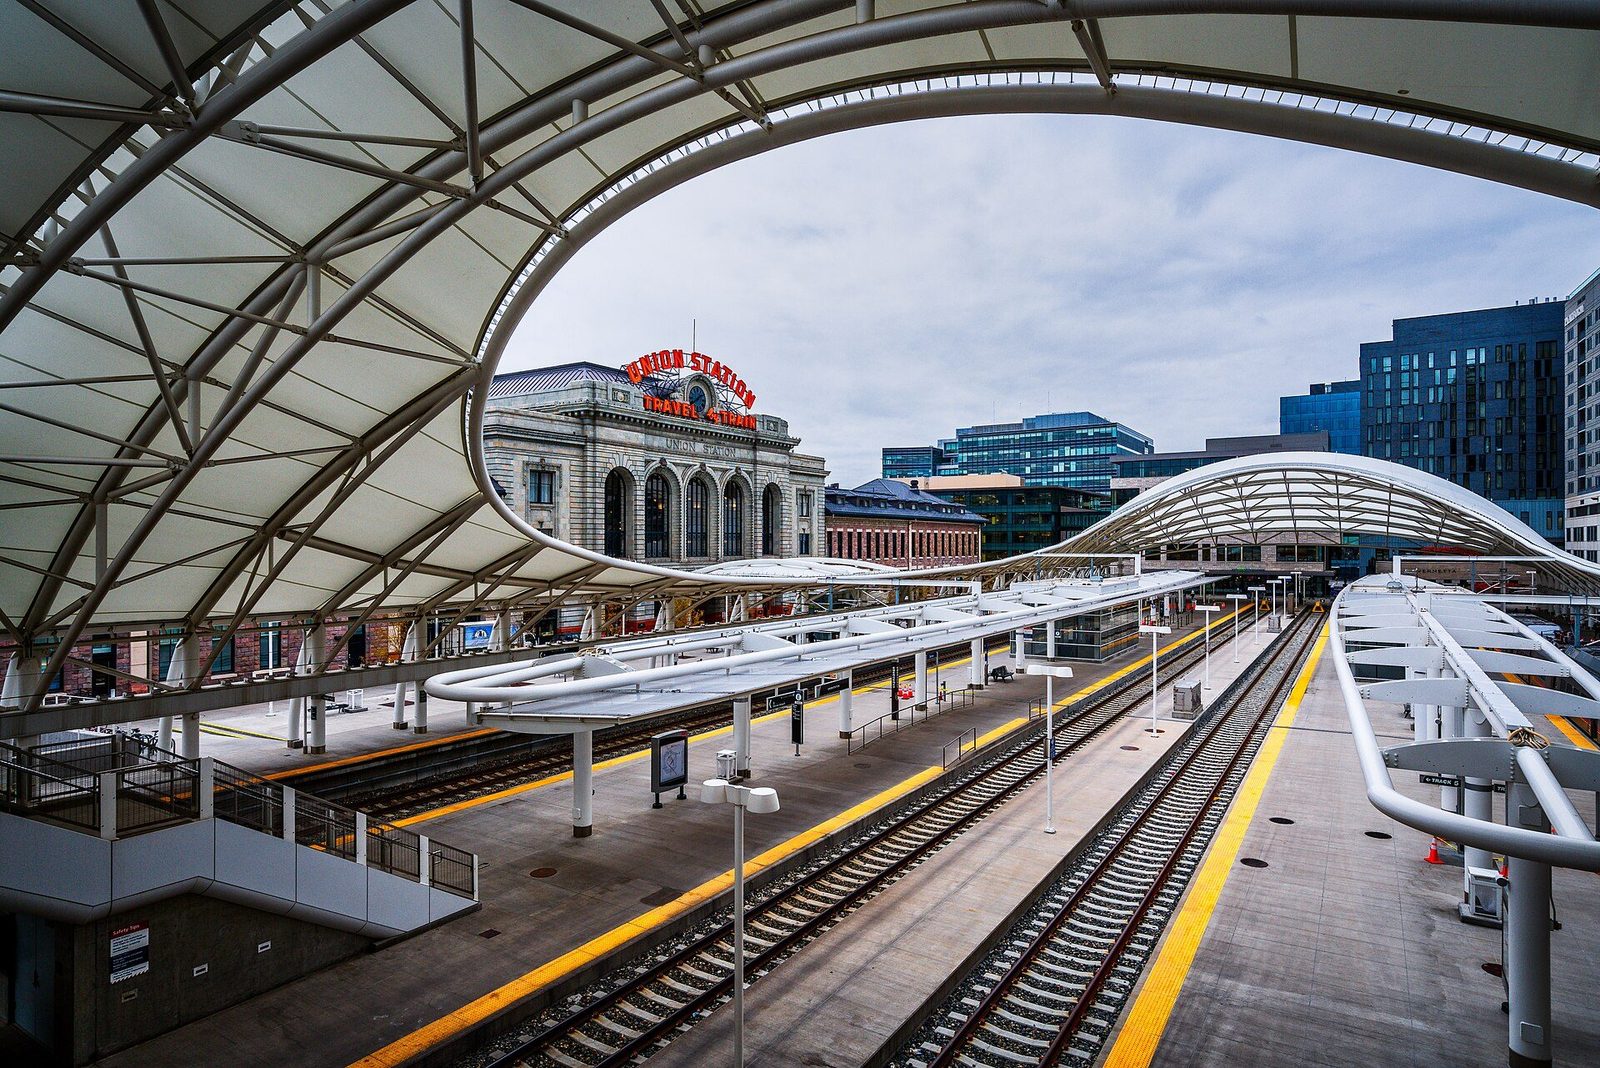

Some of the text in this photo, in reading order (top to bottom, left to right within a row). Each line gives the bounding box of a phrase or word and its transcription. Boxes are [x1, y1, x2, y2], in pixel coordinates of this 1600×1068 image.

[626, 349, 757, 410] UNION STATION
[643, 394, 699, 419] TRAVEL
[720, 410, 757, 431] TRAIN
[666, 439, 736, 457] UNION STATION
